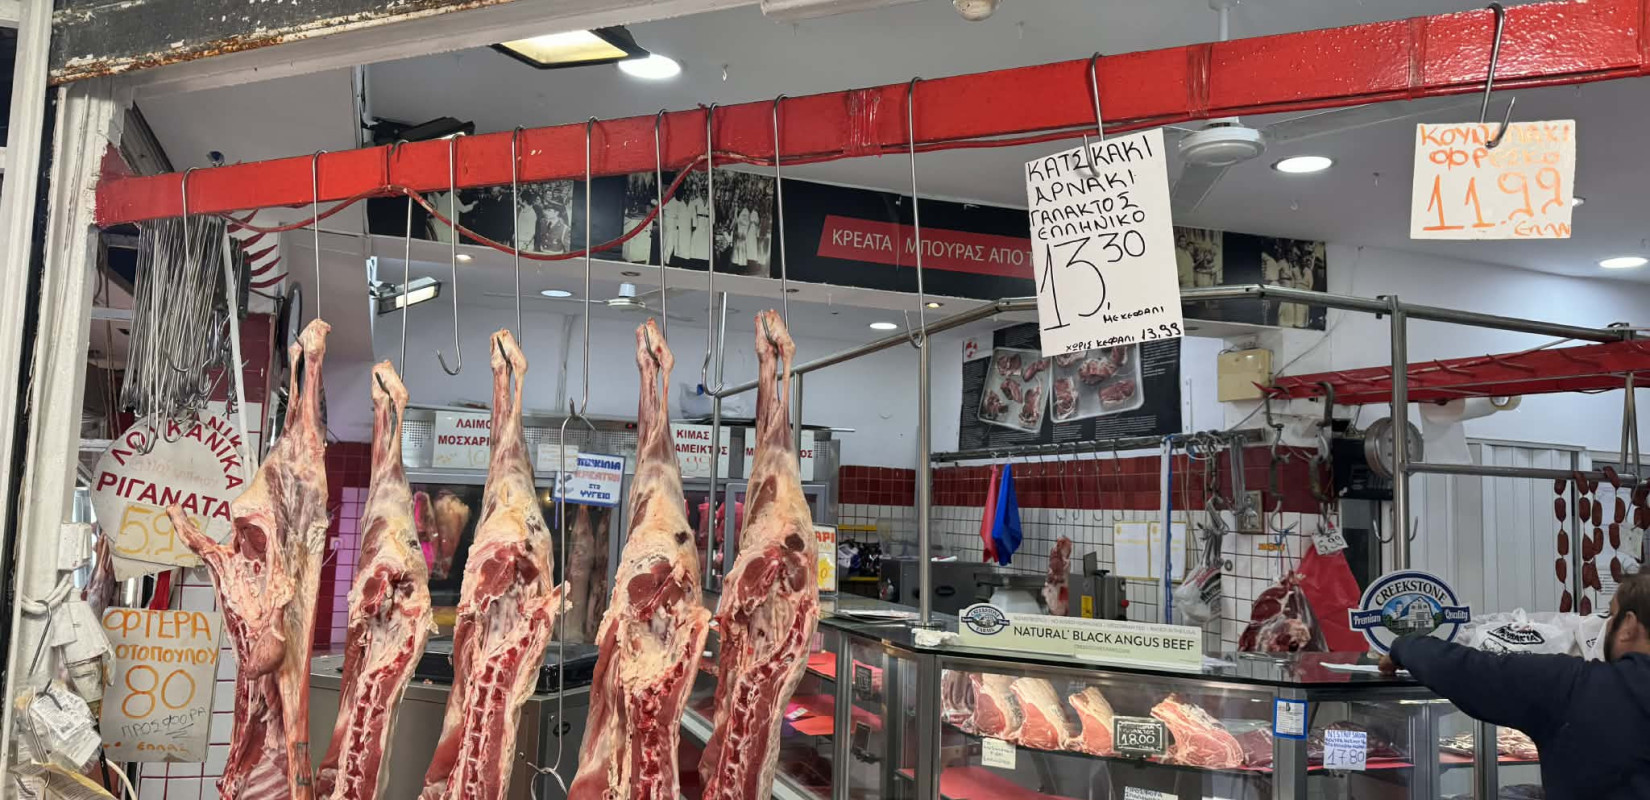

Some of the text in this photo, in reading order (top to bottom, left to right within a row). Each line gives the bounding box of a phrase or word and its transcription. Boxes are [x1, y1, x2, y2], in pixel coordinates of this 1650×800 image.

[1028, 135, 1153, 182] ΚΑΤΣΚΑΚΙ
[1036, 169, 1135, 206] ΑΡΝΑΚΙ
[1030, 191, 1139, 227] ΓΑΛΑΚΤΟΣ
[1038, 210, 1145, 240] ΕΛΛΗΝΙΚΟ
[832, 228, 893, 252] ΚΡΕΑΤΑ
[905, 237, 985, 262] ΜΠΟΥΡΑΣ
[989, 247, 1024, 266] ΑΠΟ
[675, 443, 728, 456] ΑΜΕΙΚΤΣ
[676, 429, 710, 440] ΚΙΜΑΣ
[111, 419, 243, 490] ΛΟΥΚΑΝΙΚΑ
[96, 471, 231, 522] ΡΙΓΑΝΑΤΑ
[580, 489, 611, 500] ΨΥΓΕΙΟ
[1375, 580, 1448, 606] CREEKSTONE
[102, 608, 212, 641] ΦΤΕΡΑ
[1353, 607, 1468, 625] Premium Quality
[115, 643, 219, 666] ΟΤΟΠΟΥΛΟΥ
[1072, 630, 1113, 645] BLACK
[1115, 633, 1160, 648] ANGUS
[1162, 638, 1195, 651] BEEF
